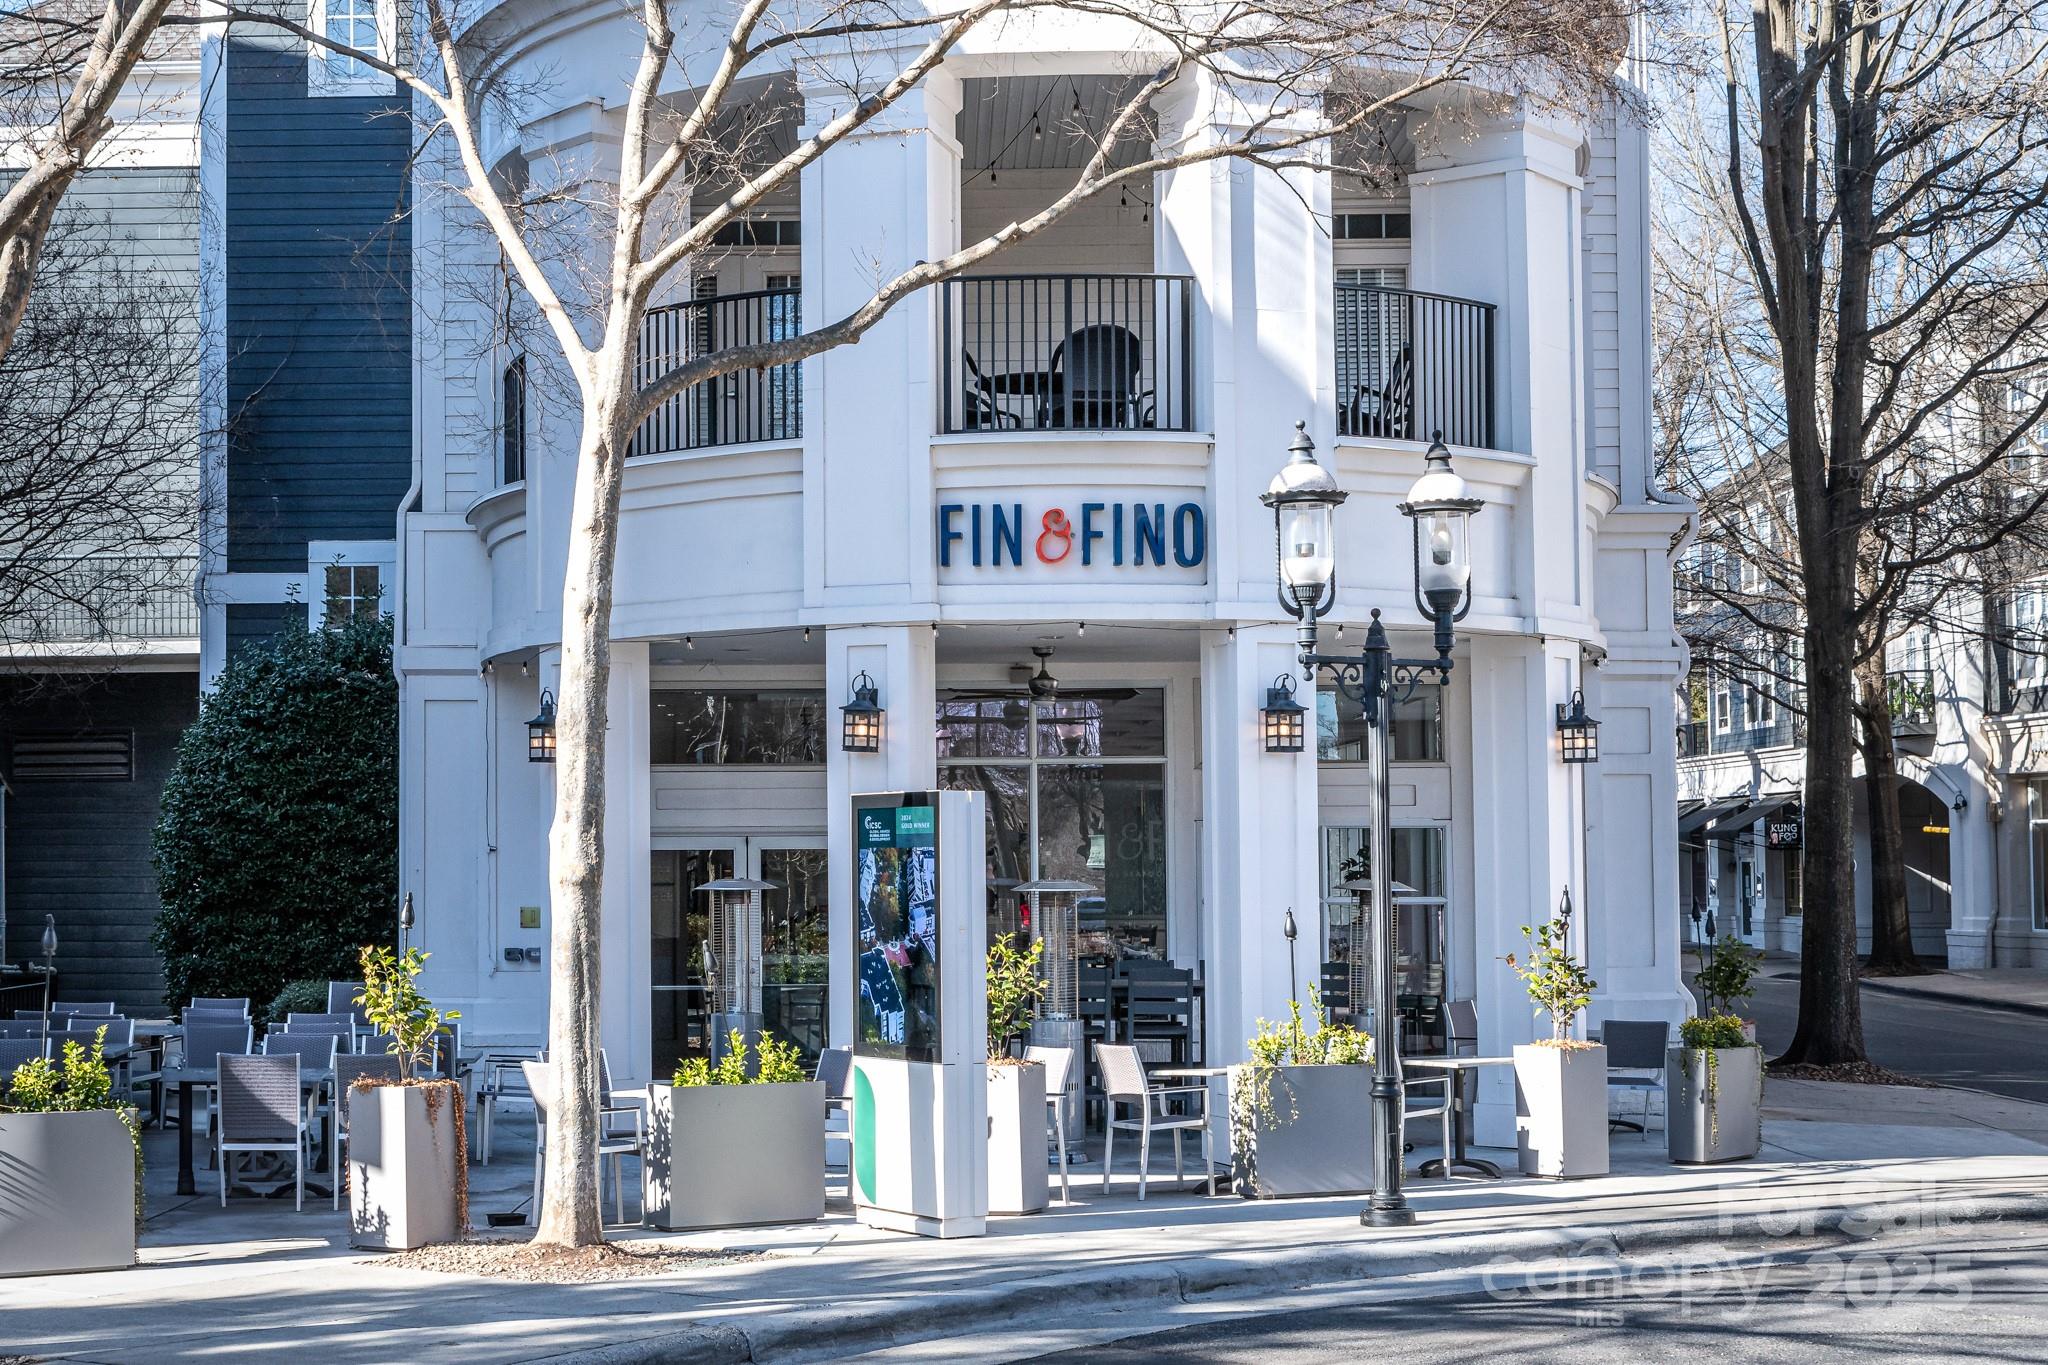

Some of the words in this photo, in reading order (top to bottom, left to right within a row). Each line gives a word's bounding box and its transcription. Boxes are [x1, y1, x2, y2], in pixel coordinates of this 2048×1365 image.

[940, 503, 1022, 567] FIN
[1035, 508, 1072, 564] &
[1081, 502, 1205, 568] FINO
[1771, 824, 1797, 832] KUNG
